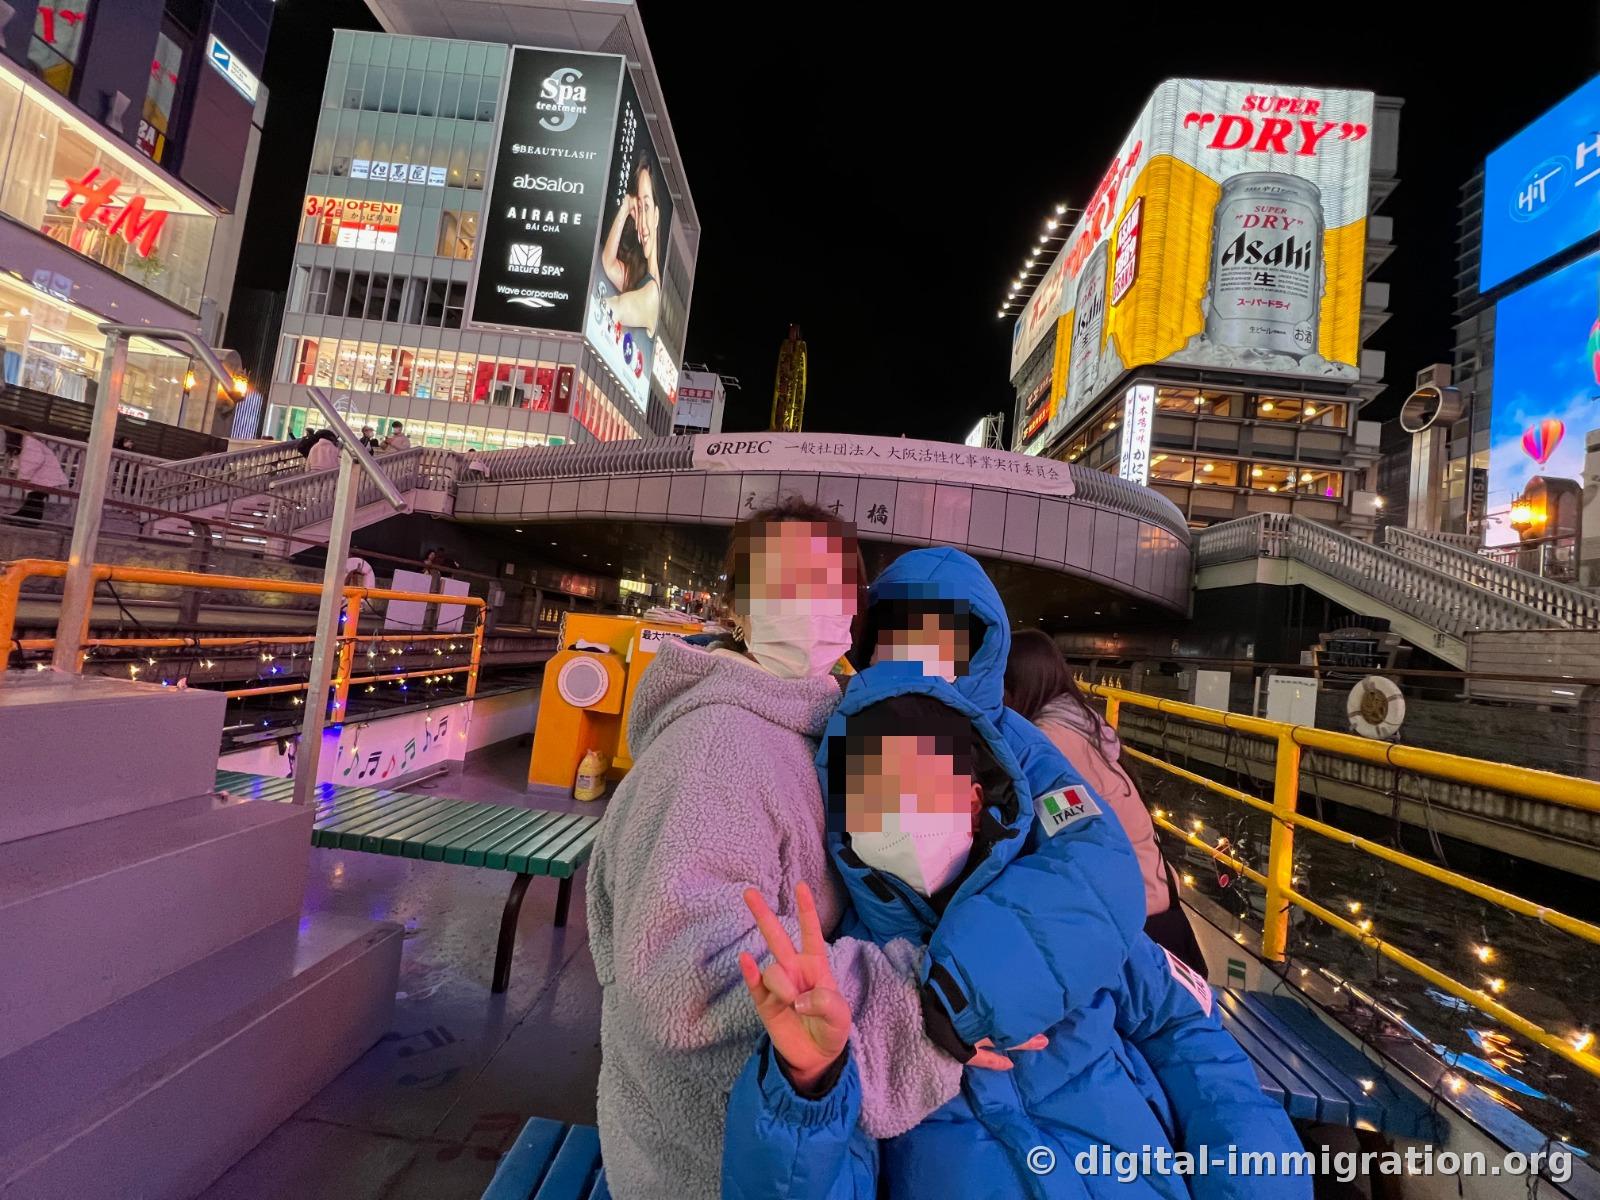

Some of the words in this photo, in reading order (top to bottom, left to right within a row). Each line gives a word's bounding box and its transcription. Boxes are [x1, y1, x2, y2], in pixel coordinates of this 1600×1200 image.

[540, 77, 587, 105] Spa
[536, 101, 587, 114] treatment
[1241, 95, 1321, 115] SUPER
[513, 174, 584, 194] abSalon
[58, 167, 169, 257] H&M
[346, 201, 399, 214] OPEN!
[507, 206, 582, 225] AIRARE
[1254, 205, 1288, 214] SUPER
[1221, 231, 1312, 272] Asahi
[508, 265, 540, 274] nature
[541, 266, 561, 276] SPA
[1254, 272, 1276, 287] 生
[497, 285, 520, 295] Wave
[521, 289, 569, 300] corporation
[1237, 298, 1291, 310] スーパードライ
[785, 442, 881, 457] 一般社団法人
[888, 446, 1060, 481] 大阪活性化事業実行委員会
[1053, 805, 1084, 825] ITALY
